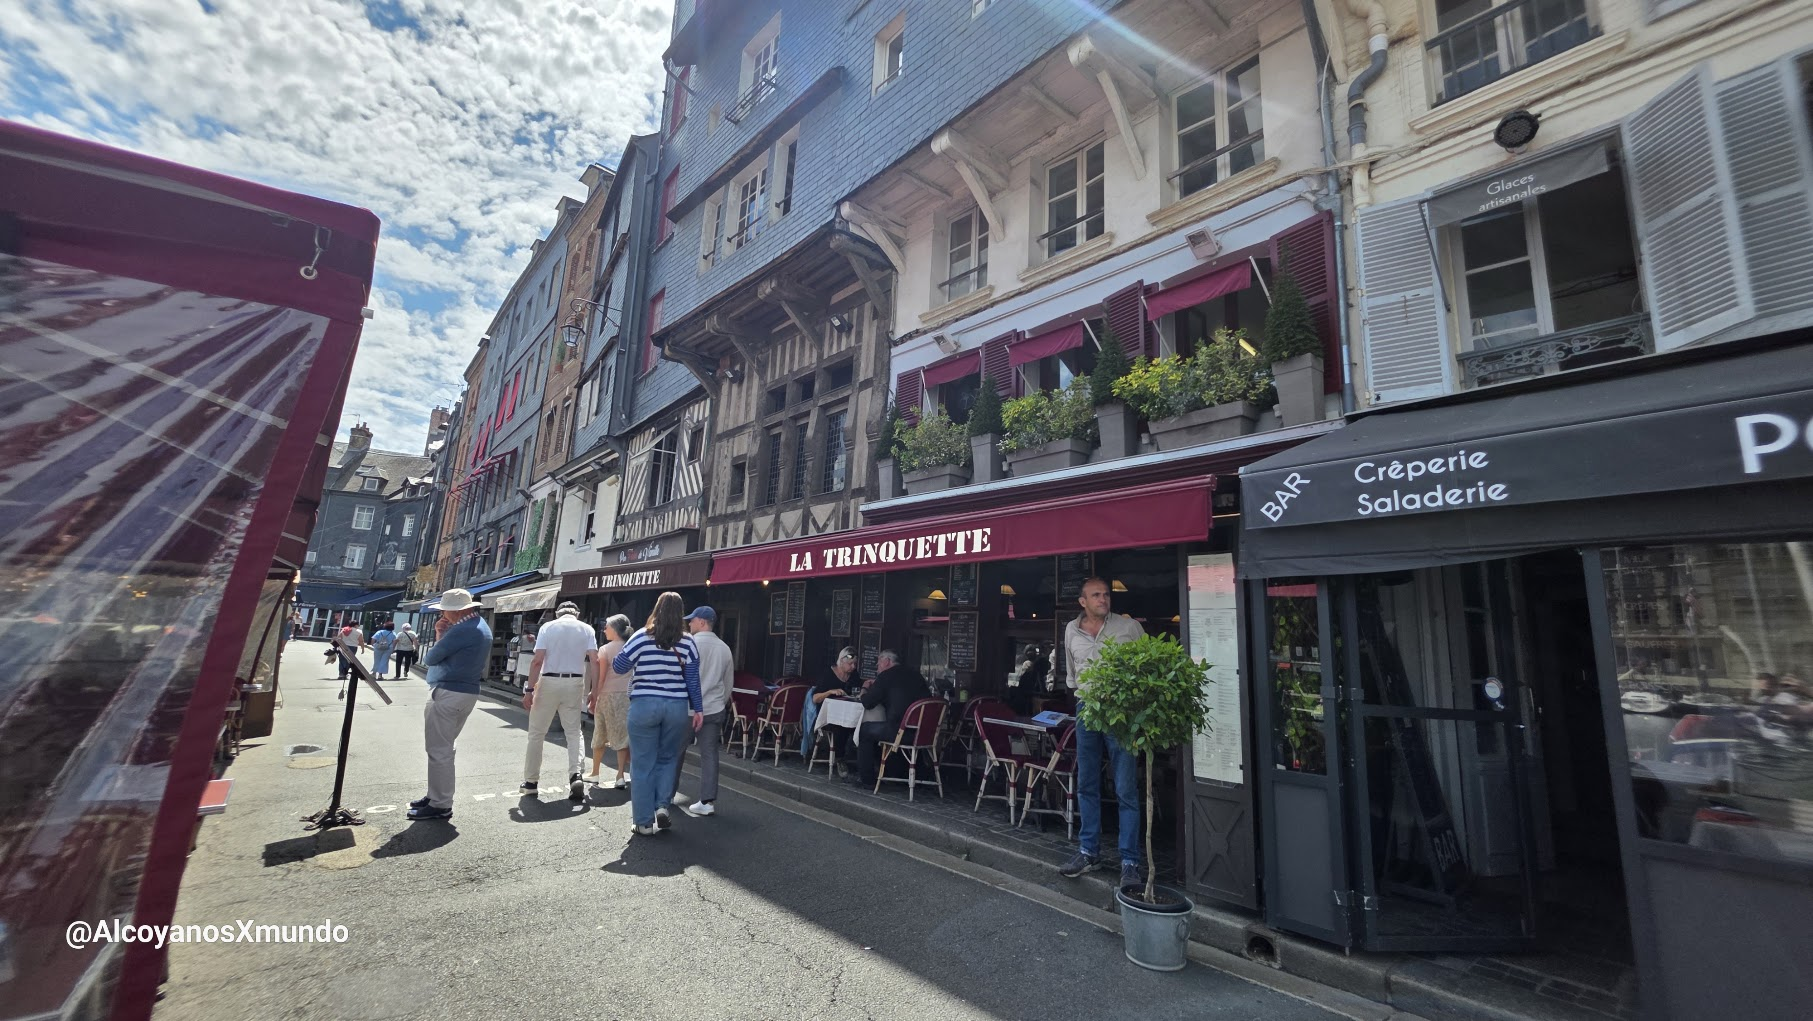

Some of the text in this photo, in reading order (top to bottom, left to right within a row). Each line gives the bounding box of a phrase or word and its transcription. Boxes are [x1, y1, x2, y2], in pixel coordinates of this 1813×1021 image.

[1478, 184, 1547, 212] artisanales
[1486, 174, 1534, 194] Glaces
[1735, 413, 1813, 474] P
[1354, 450, 1489, 484] Crêperie
[1260, 471, 1311, 523] BAR
[1357, 481, 1509, 516] Saladerie
[789, 527, 991, 572] LA TRINQUETTE
[587, 569, 661, 589] LA TRINQUETTE
